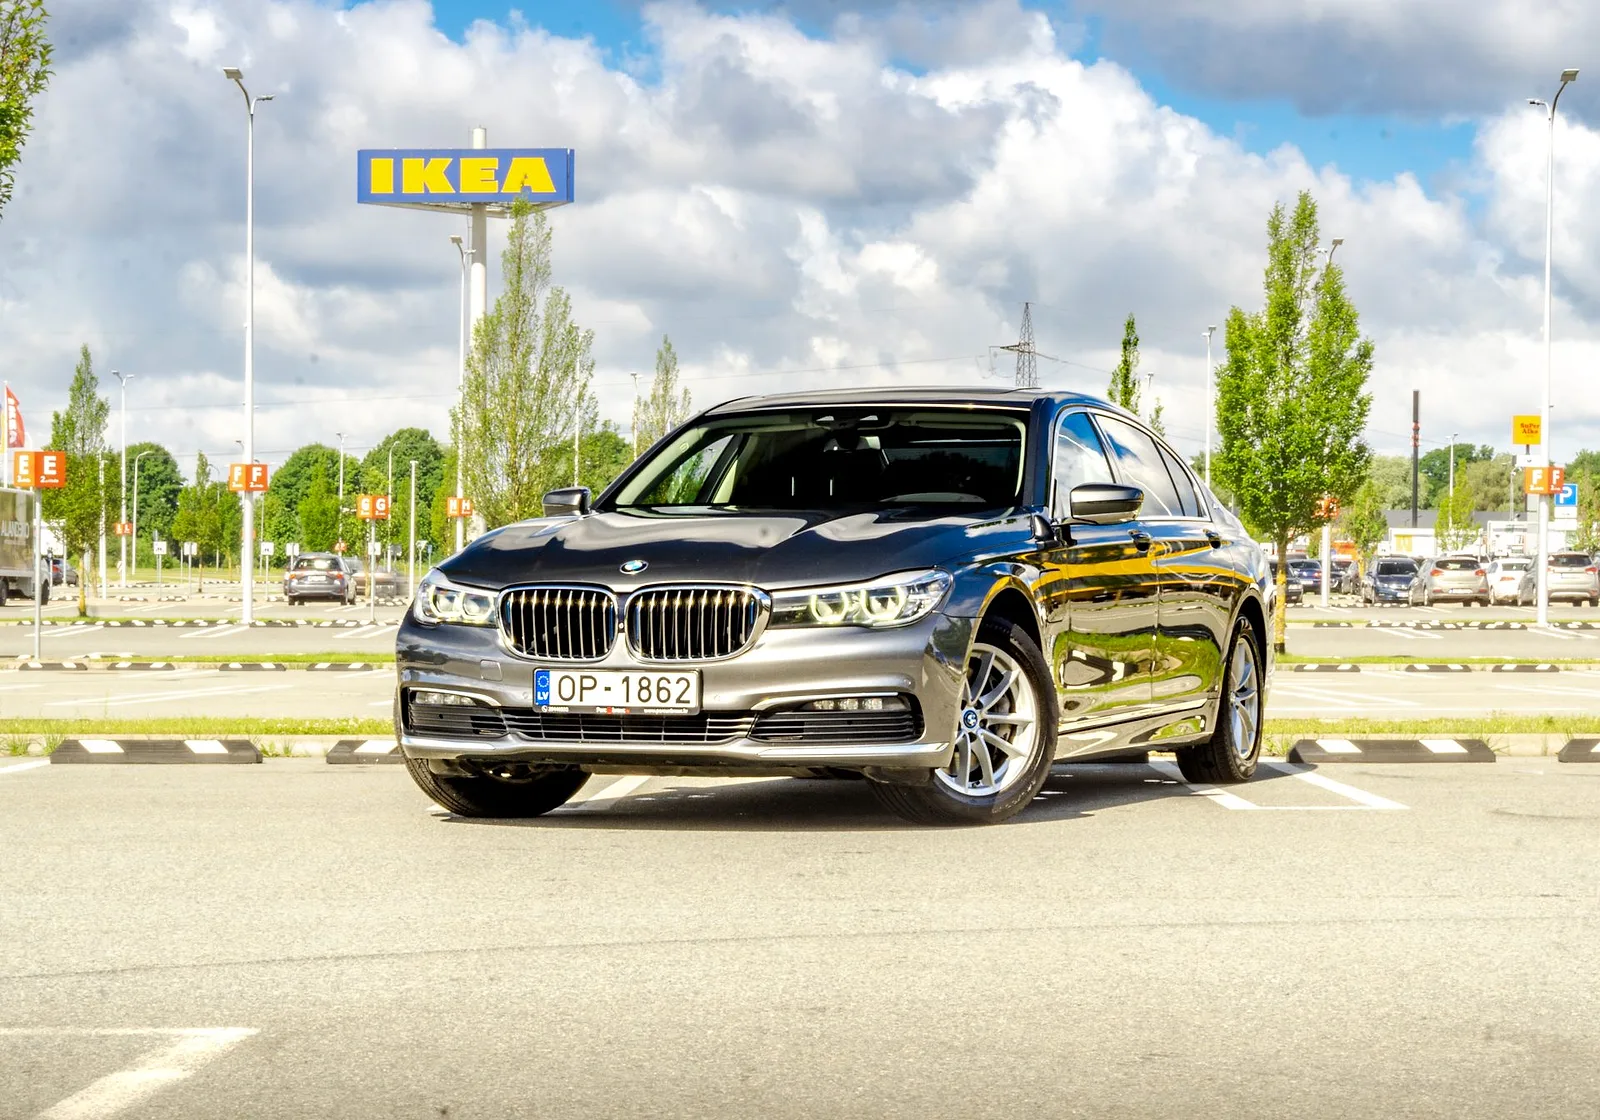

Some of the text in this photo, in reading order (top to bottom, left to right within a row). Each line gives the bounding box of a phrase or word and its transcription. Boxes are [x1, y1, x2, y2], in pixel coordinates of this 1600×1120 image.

[370, 157, 557, 194] IKEA
[19, 455, 29, 475] E
[43, 455, 57, 475] E
[234, 466, 242, 482] F
[252, 466, 262, 482] F
[1532, 469, 1543, 485] F
[1552, 470, 1560, 485] F
[1559, 486, 1573, 504] P
[376, 498, 386, 511] G
[461, 499, 471, 509] H
[537, 692, 549, 700] LV
[558, 675, 691, 704] OP-1862
